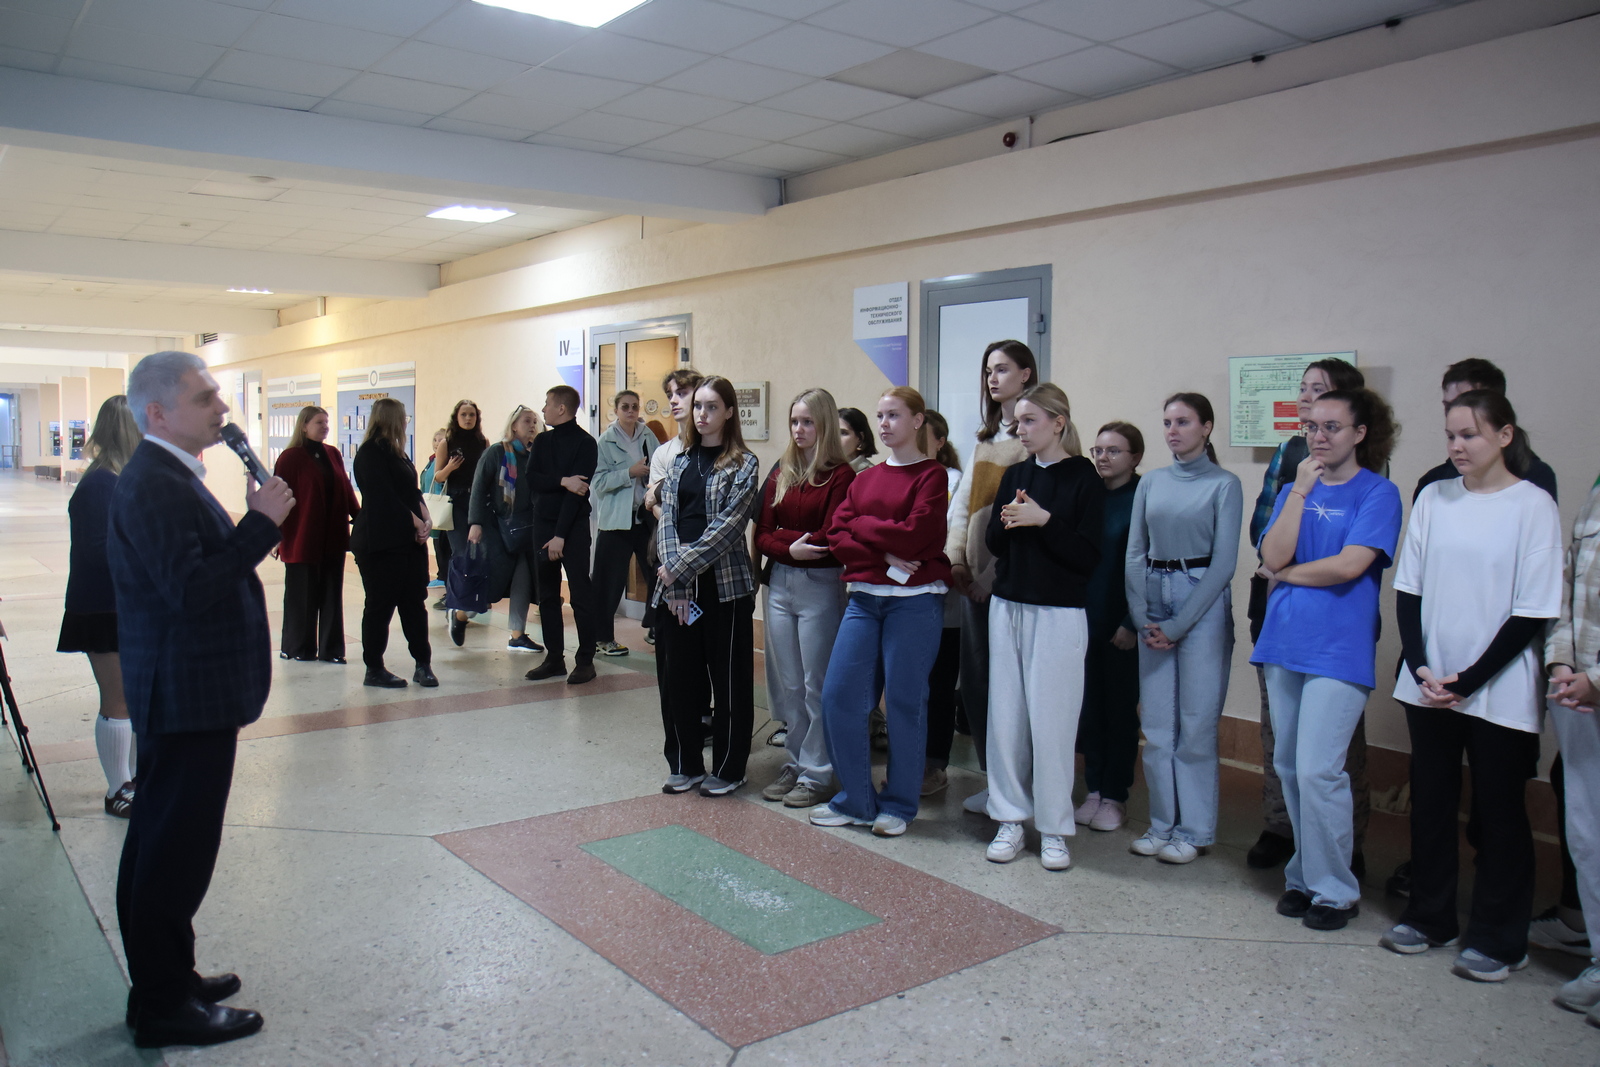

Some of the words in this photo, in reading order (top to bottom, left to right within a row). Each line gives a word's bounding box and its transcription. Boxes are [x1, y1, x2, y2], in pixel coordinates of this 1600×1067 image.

[870, 310, 902, 318] ТЕХНИЧЕСКОГО
[867, 317, 902, 325] ОБСЛУЖИВАНИЯ
[559, 339, 570, 356] IV
